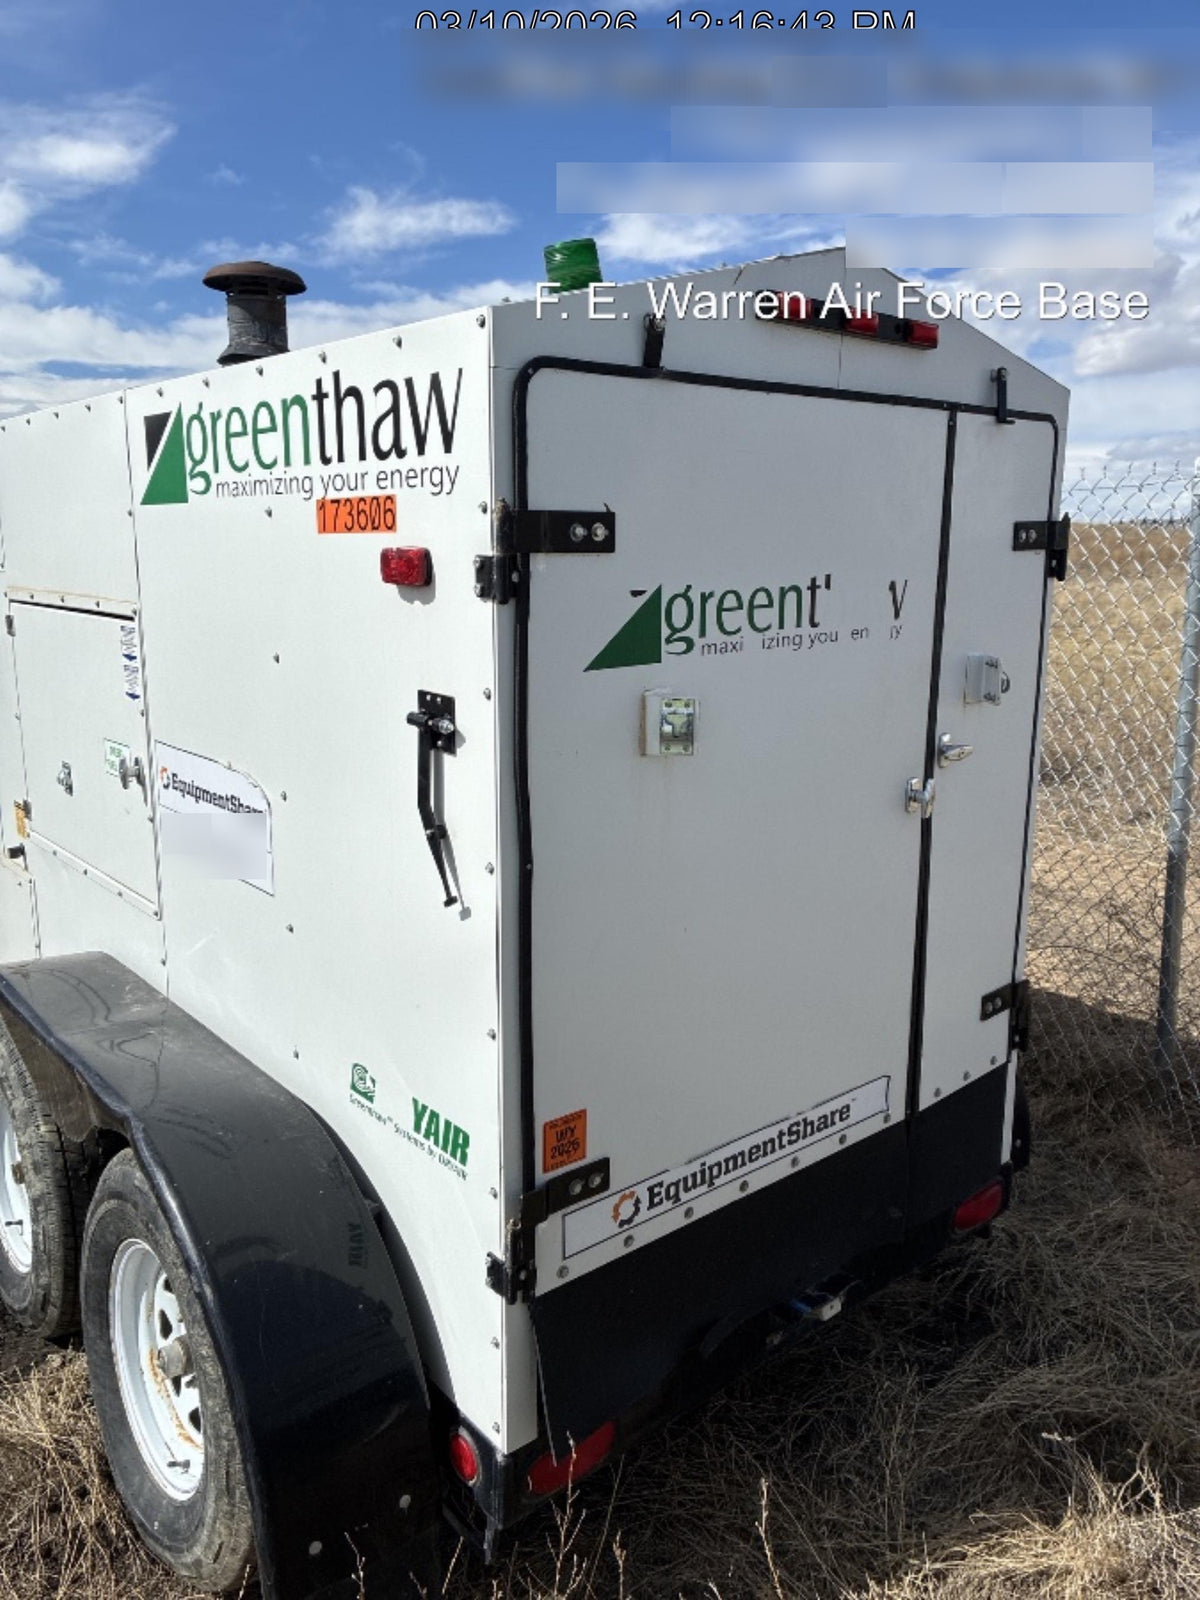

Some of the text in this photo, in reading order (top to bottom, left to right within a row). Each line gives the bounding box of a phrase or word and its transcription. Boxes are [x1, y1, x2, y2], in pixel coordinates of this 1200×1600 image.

[186, 368, 463, 495] greenthaw
[216, 465, 460, 500] maximizing your energy
[318, 496, 396, 532] 173606
[646, 1102, 851, 1212] EquipmentShare
